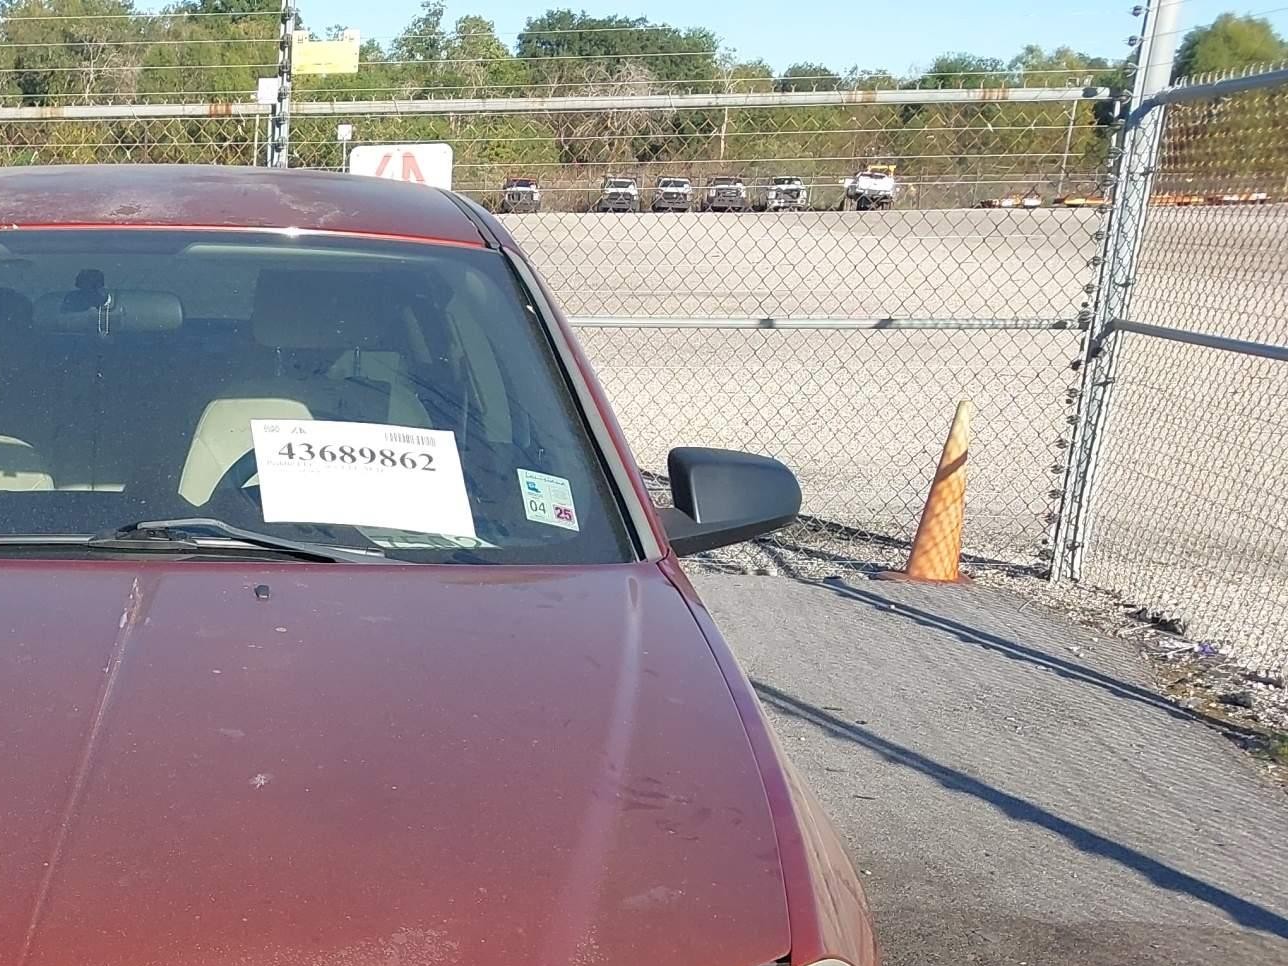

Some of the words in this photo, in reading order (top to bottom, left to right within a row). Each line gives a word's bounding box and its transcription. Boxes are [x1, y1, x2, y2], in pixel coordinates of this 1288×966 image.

[278, 442, 437, 472] 43689862
[529, 499, 546, 514] 04
[554, 506, 572, 521] 25
